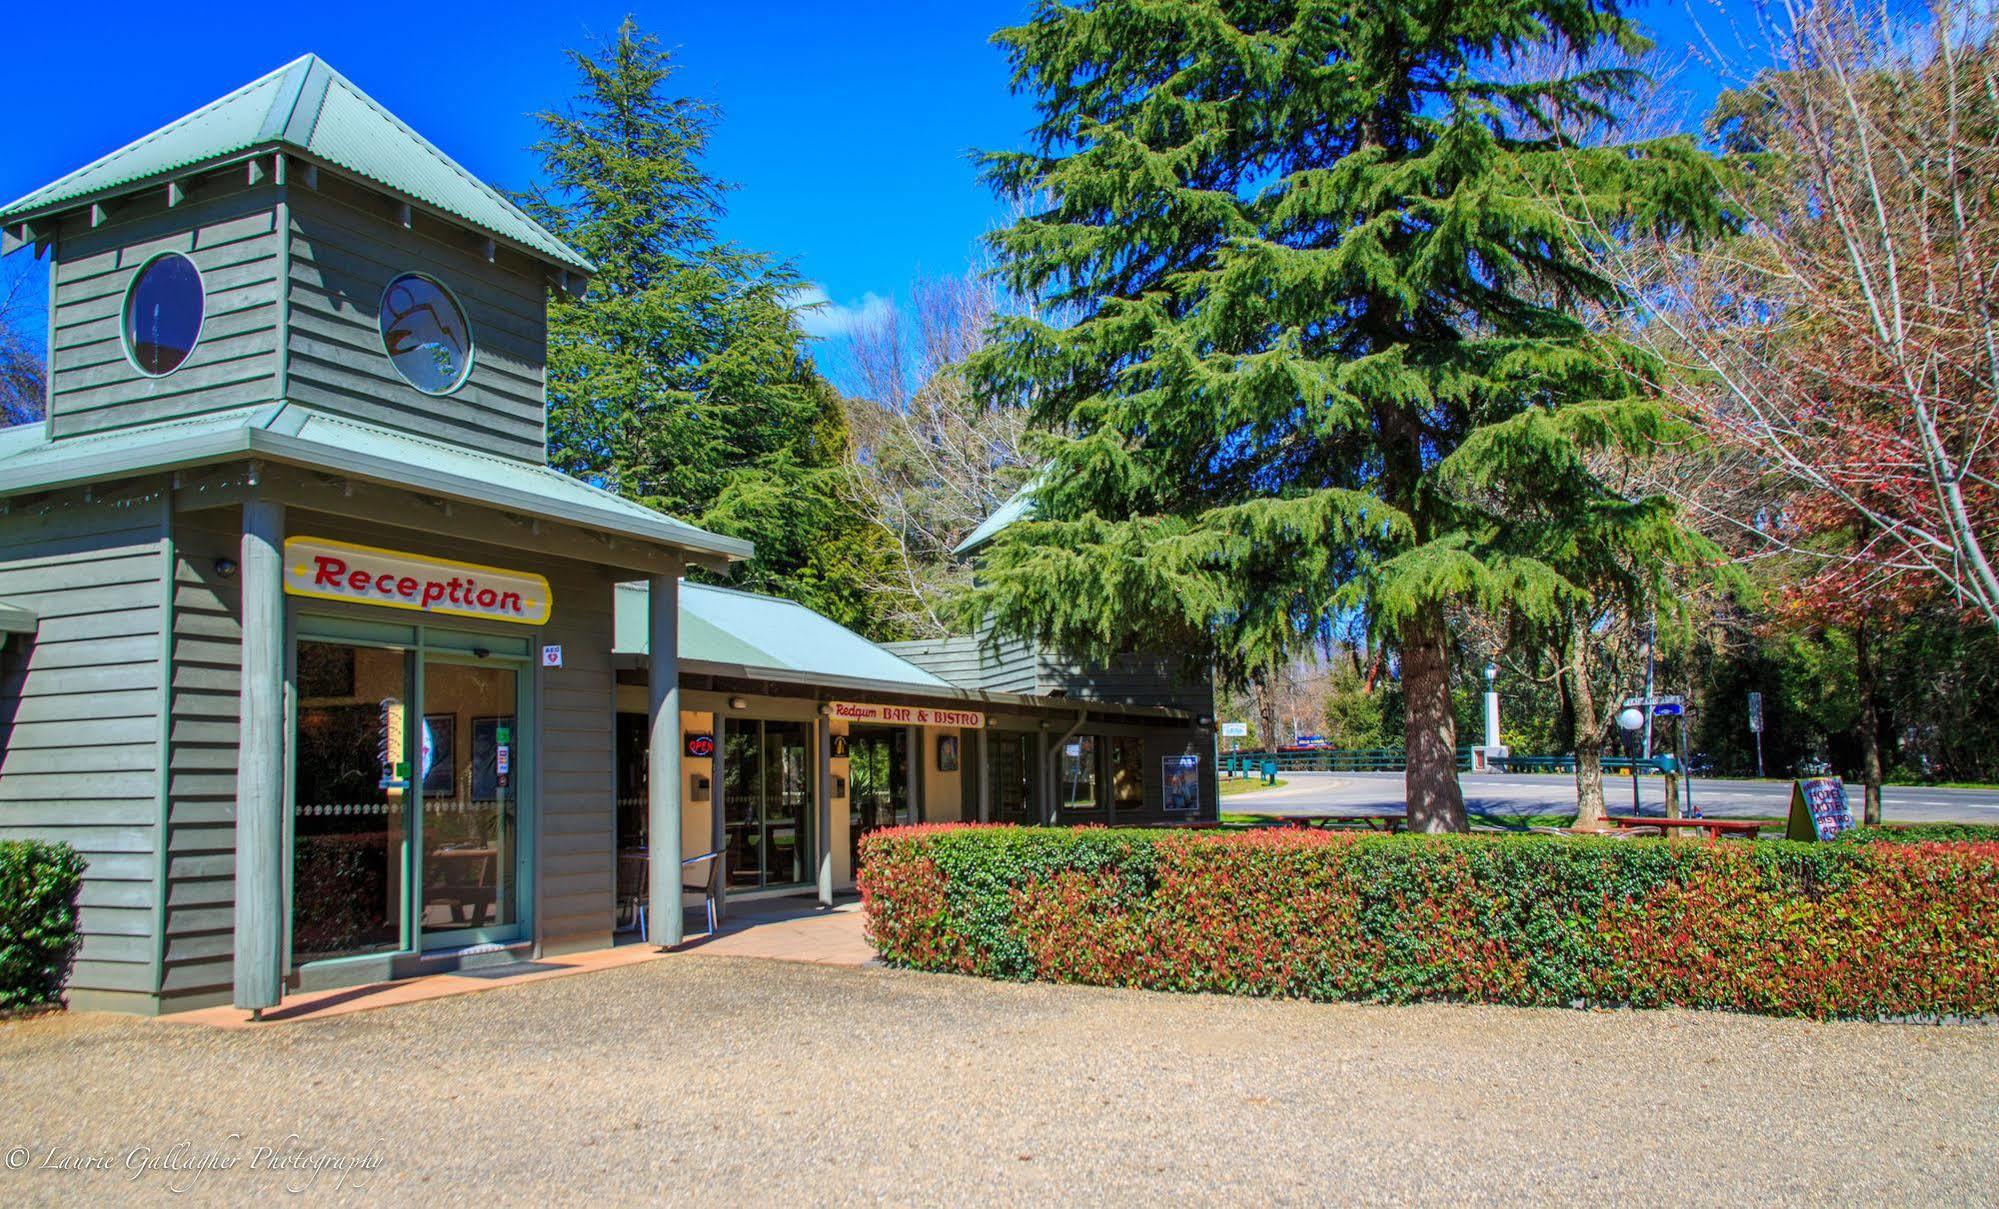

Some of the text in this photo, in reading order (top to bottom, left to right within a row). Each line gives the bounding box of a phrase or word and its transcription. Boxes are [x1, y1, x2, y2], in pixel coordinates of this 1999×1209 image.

[313, 555, 523, 613] Reception
[835, 703, 979, 725] Redgum BAR & BISTRO
[689, 739, 714, 753] OPEN
[1808, 789, 1847, 801] HOTEL
[1810, 801, 1848, 813] MOTEL
[1816, 814, 1850, 825] BISTRO
